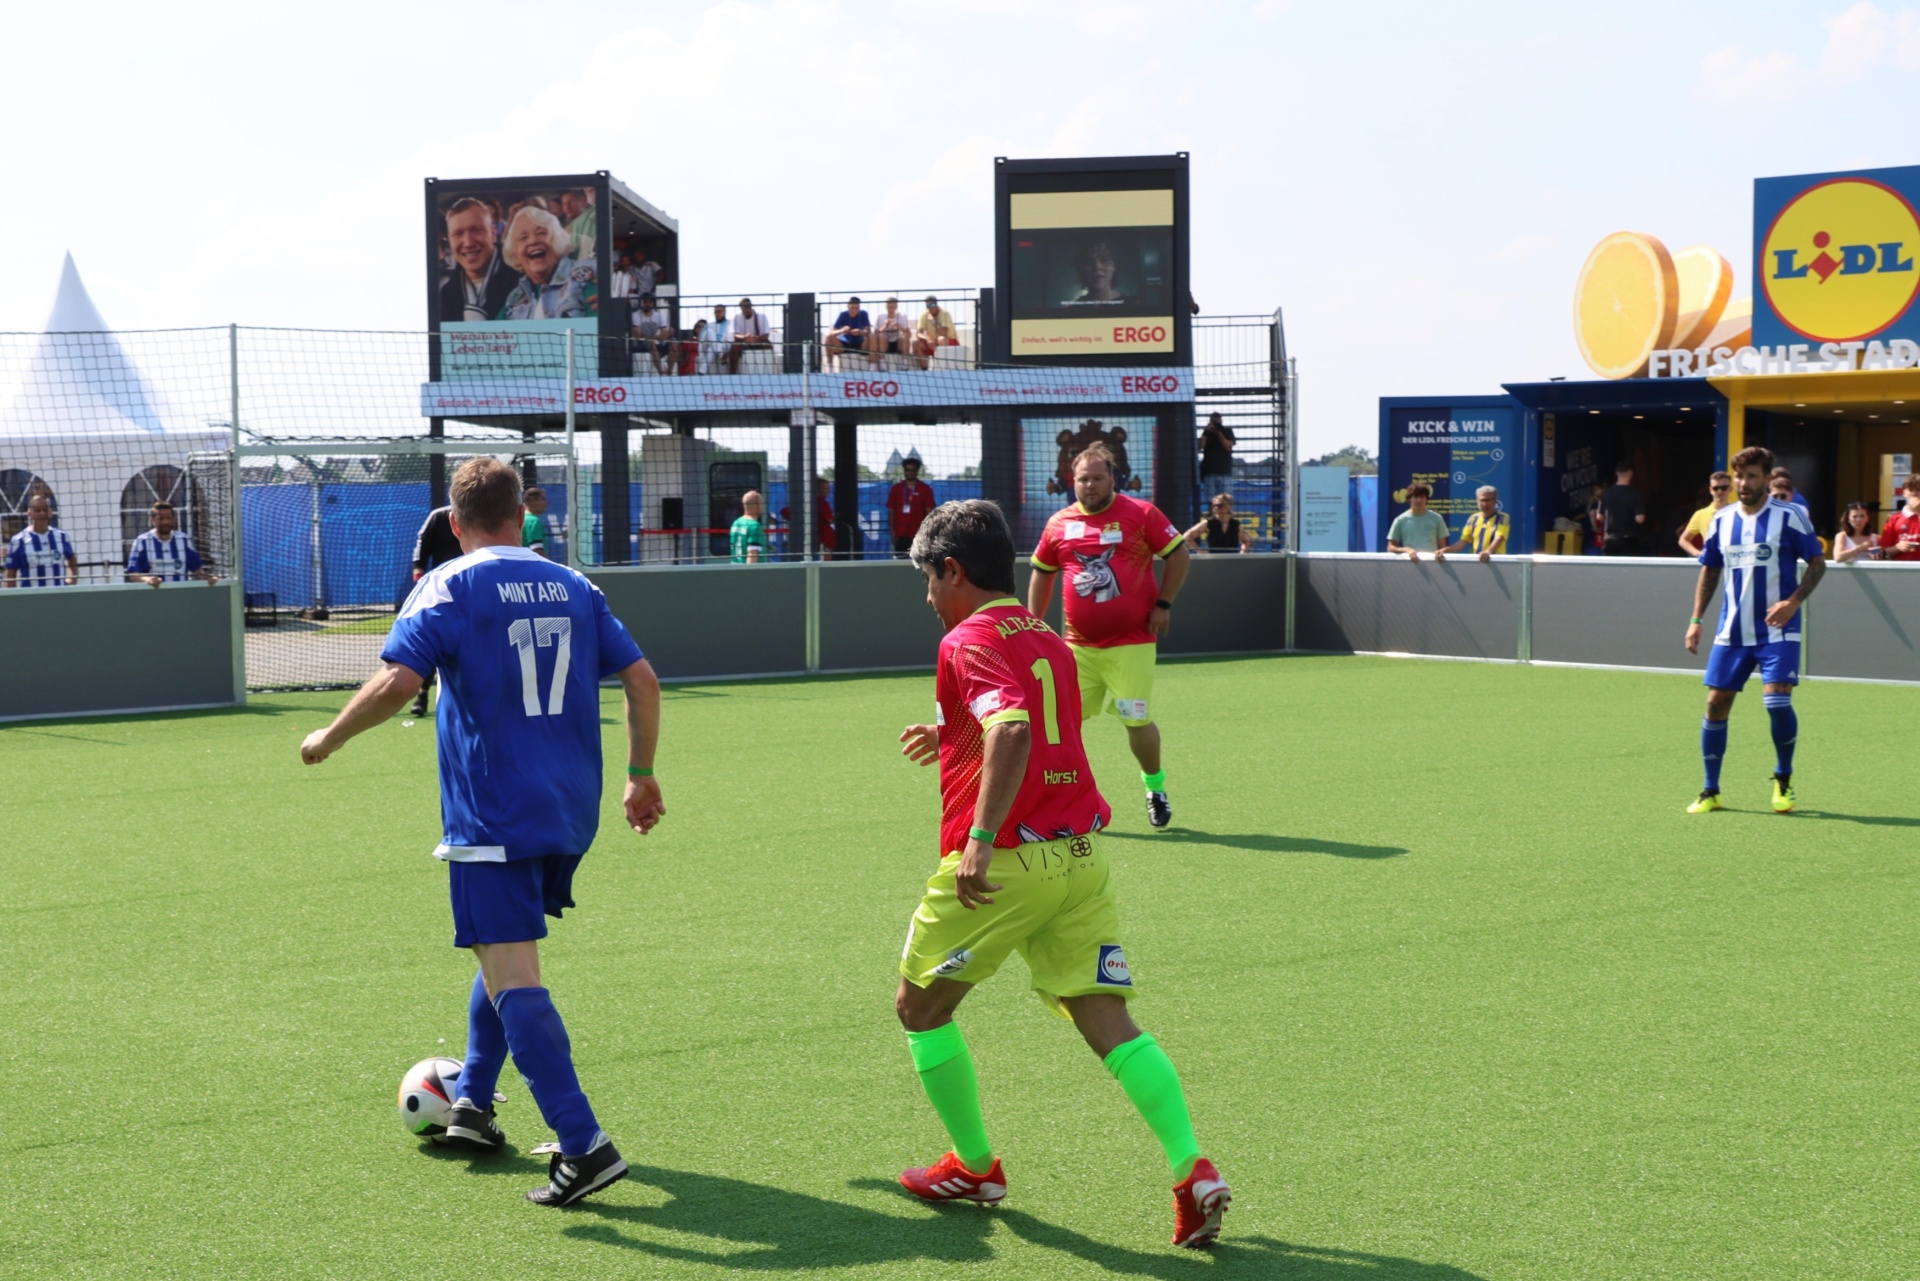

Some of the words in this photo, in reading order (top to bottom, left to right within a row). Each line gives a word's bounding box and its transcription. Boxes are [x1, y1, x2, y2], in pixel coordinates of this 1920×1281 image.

[1113, 326, 1166, 343] ERGO
[1648, 343, 1810, 379] FRISCHE
[844, 380, 899, 398] ERGO
[1121, 376, 1179, 393] ERGO
[573, 386, 627, 404] ERGO
[1408, 421, 1445, 433] KICK
[1447, 420, 1459, 432] &
[1462, 420, 1495, 432] WIN
[1418, 436, 1436, 444] LIDL
[1436, 436, 1468, 444] FRISCHE
[1103, 522, 1120, 533] 23
[507, 617, 572, 717] 17
[1030, 657, 1061, 745] 1
[1044, 769, 1078, 785] Horst
